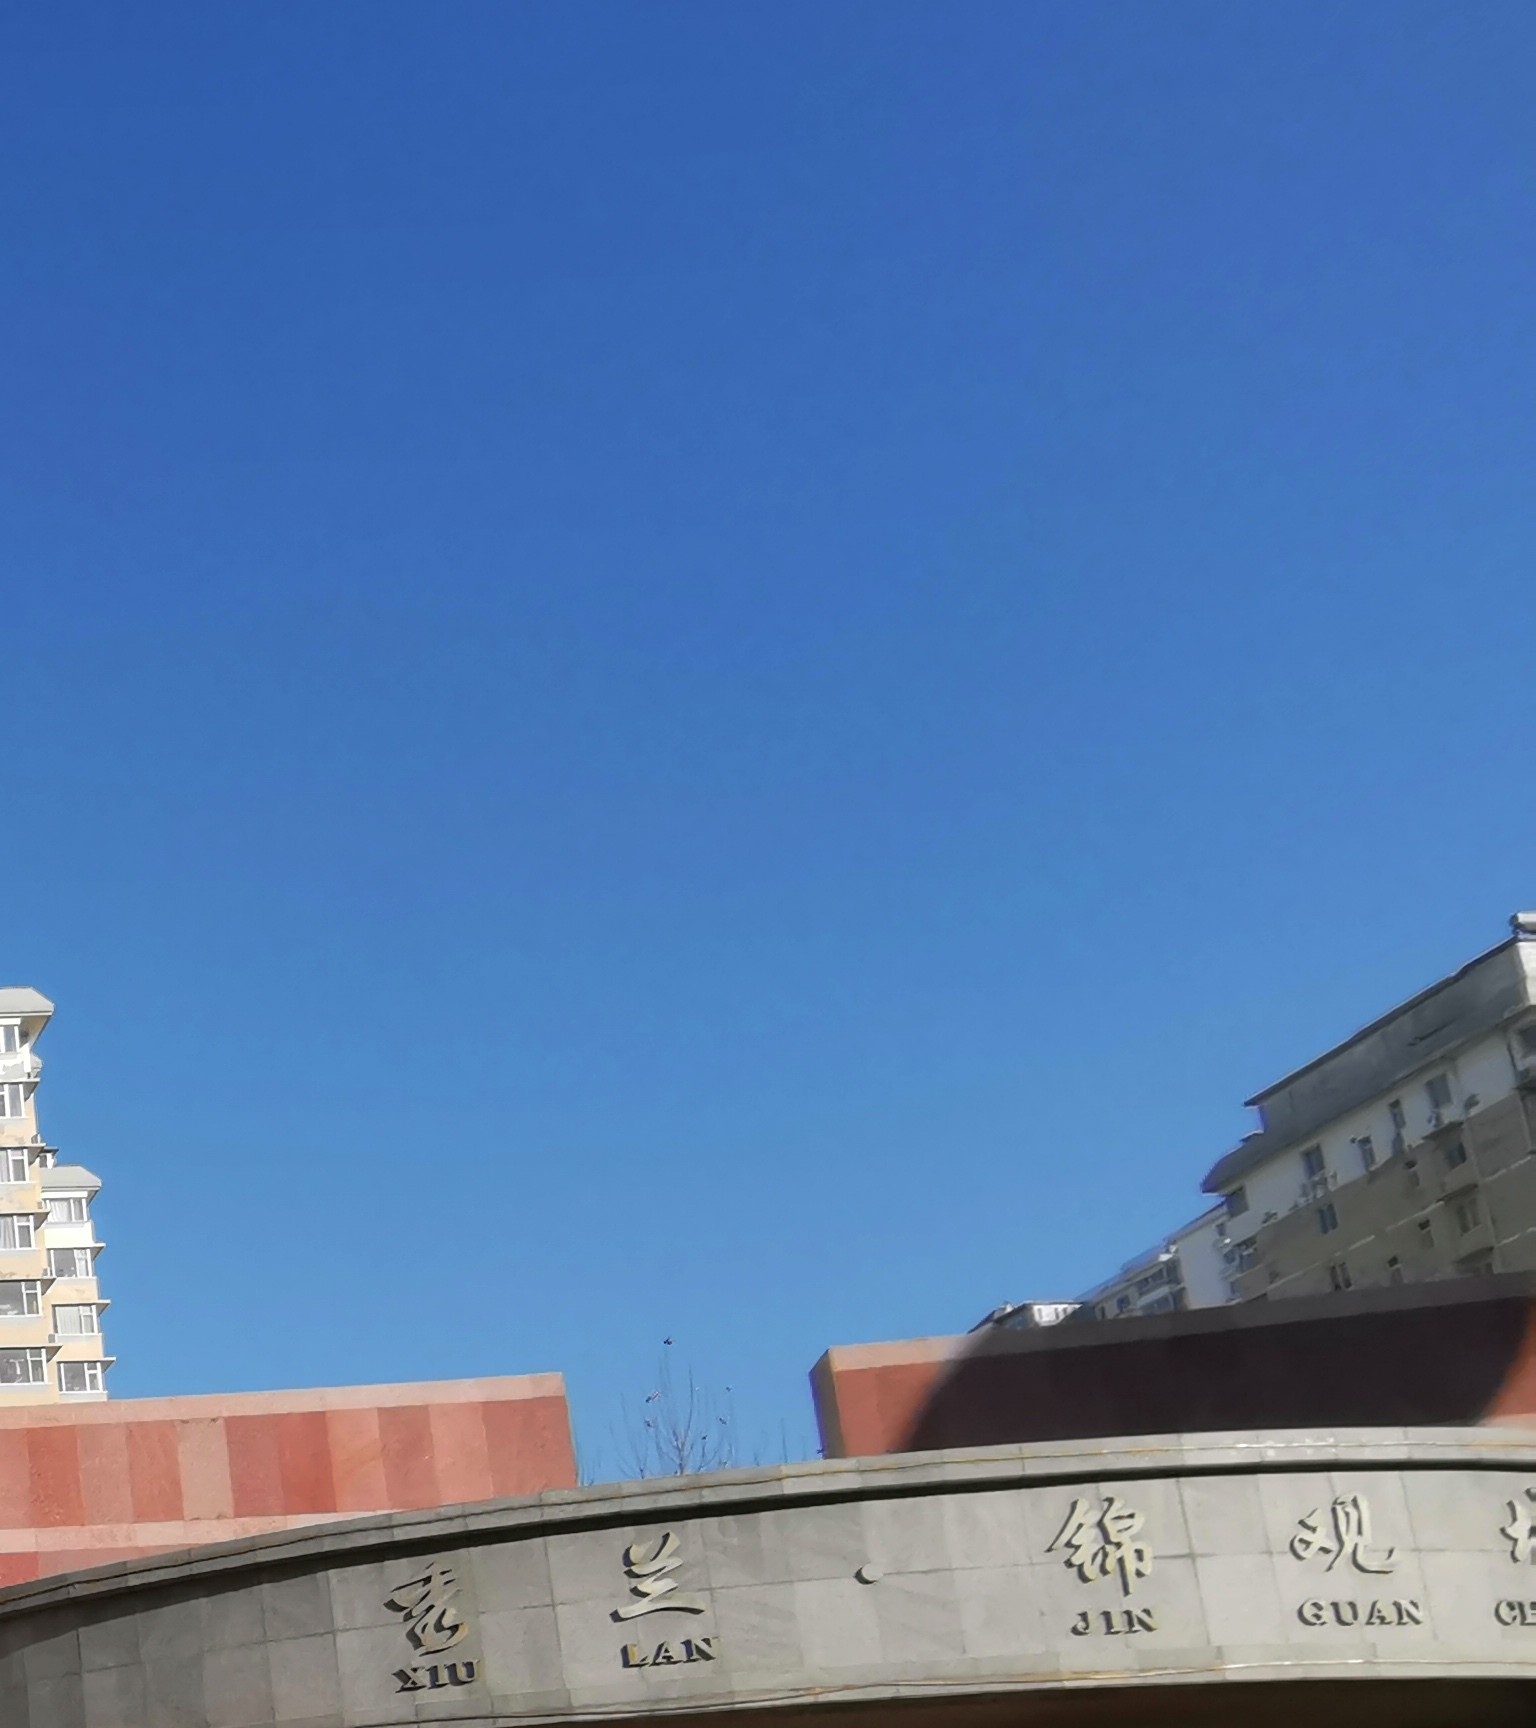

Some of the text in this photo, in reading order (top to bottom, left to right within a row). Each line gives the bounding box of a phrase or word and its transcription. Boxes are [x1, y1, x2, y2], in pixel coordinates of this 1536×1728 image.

[391, 1660, 483, 1694] XIU
[619, 1635, 719, 1669] LAN
[1070, 1606, 1160, 1636] JIN
[1297, 1598, 1425, 1626] GUAN
